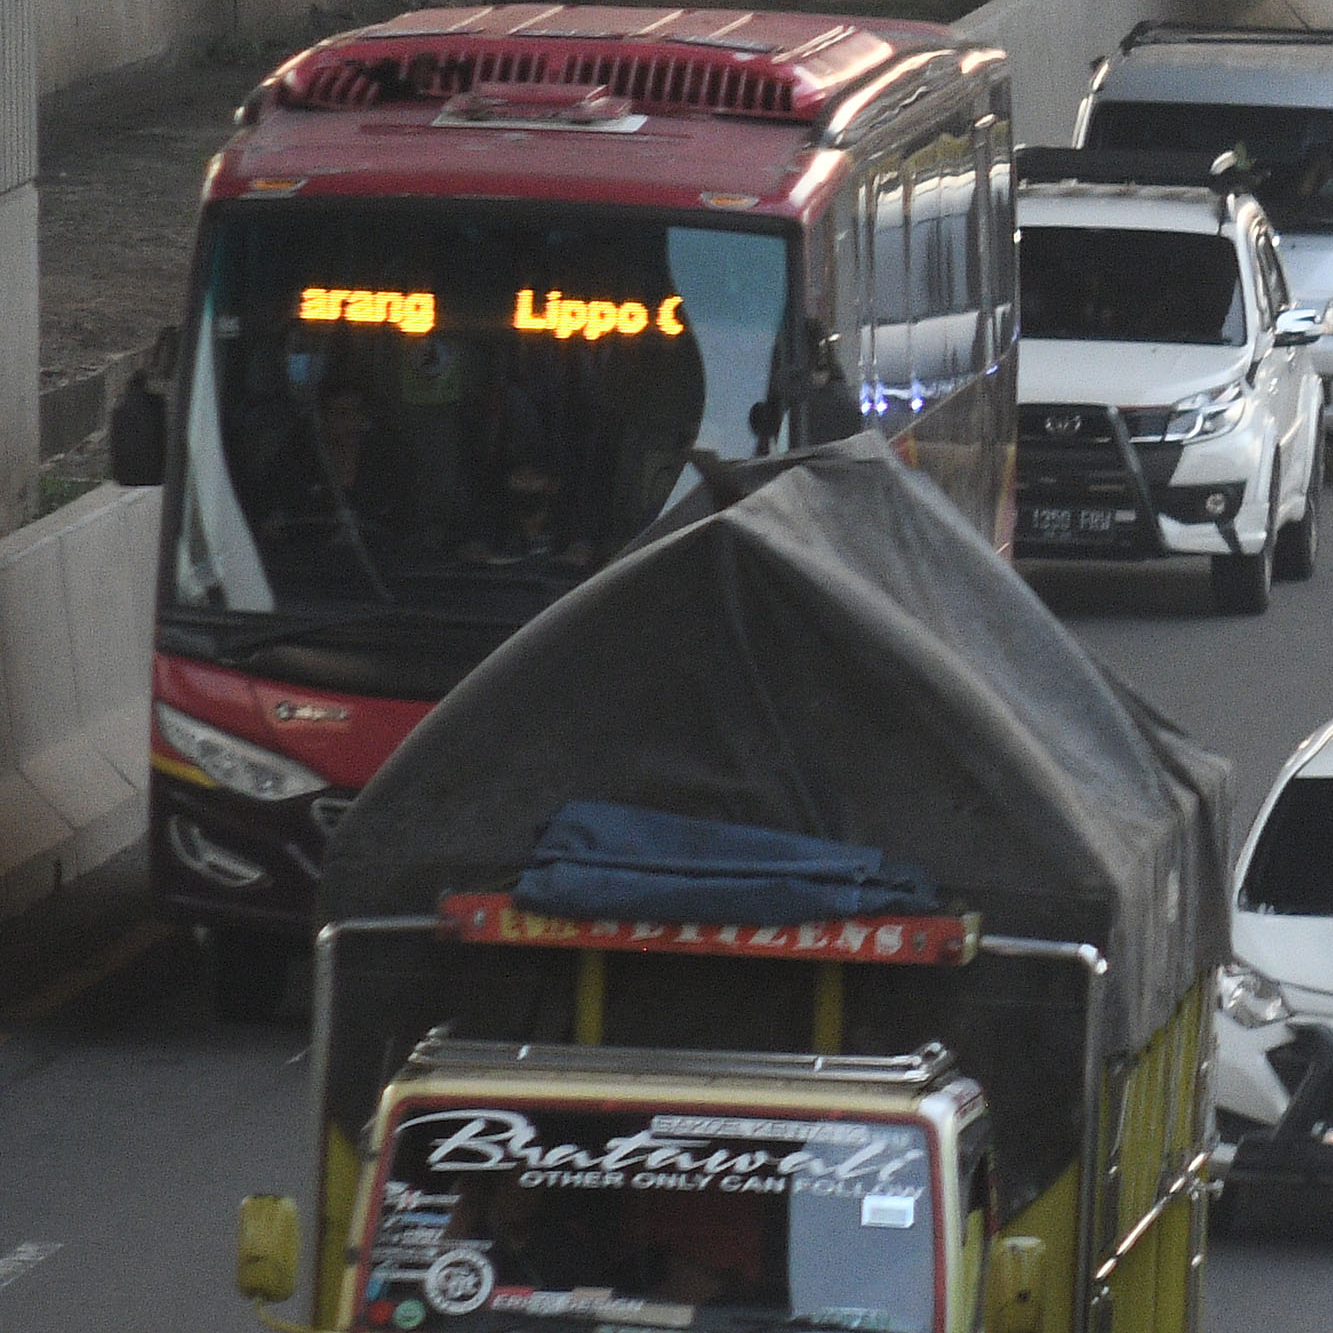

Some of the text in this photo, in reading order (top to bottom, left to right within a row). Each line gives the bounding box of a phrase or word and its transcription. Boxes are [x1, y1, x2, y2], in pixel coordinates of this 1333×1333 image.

[301, 288, 435, 333] arang
[513, 289, 649, 340] Lippo
[394, 1108, 924, 1181] Bratawali
[519, 1170, 624, 1189] OTHER
[631, 1171, 712, 1191] ONLY
[719, 1175, 786, 1194] CAN
